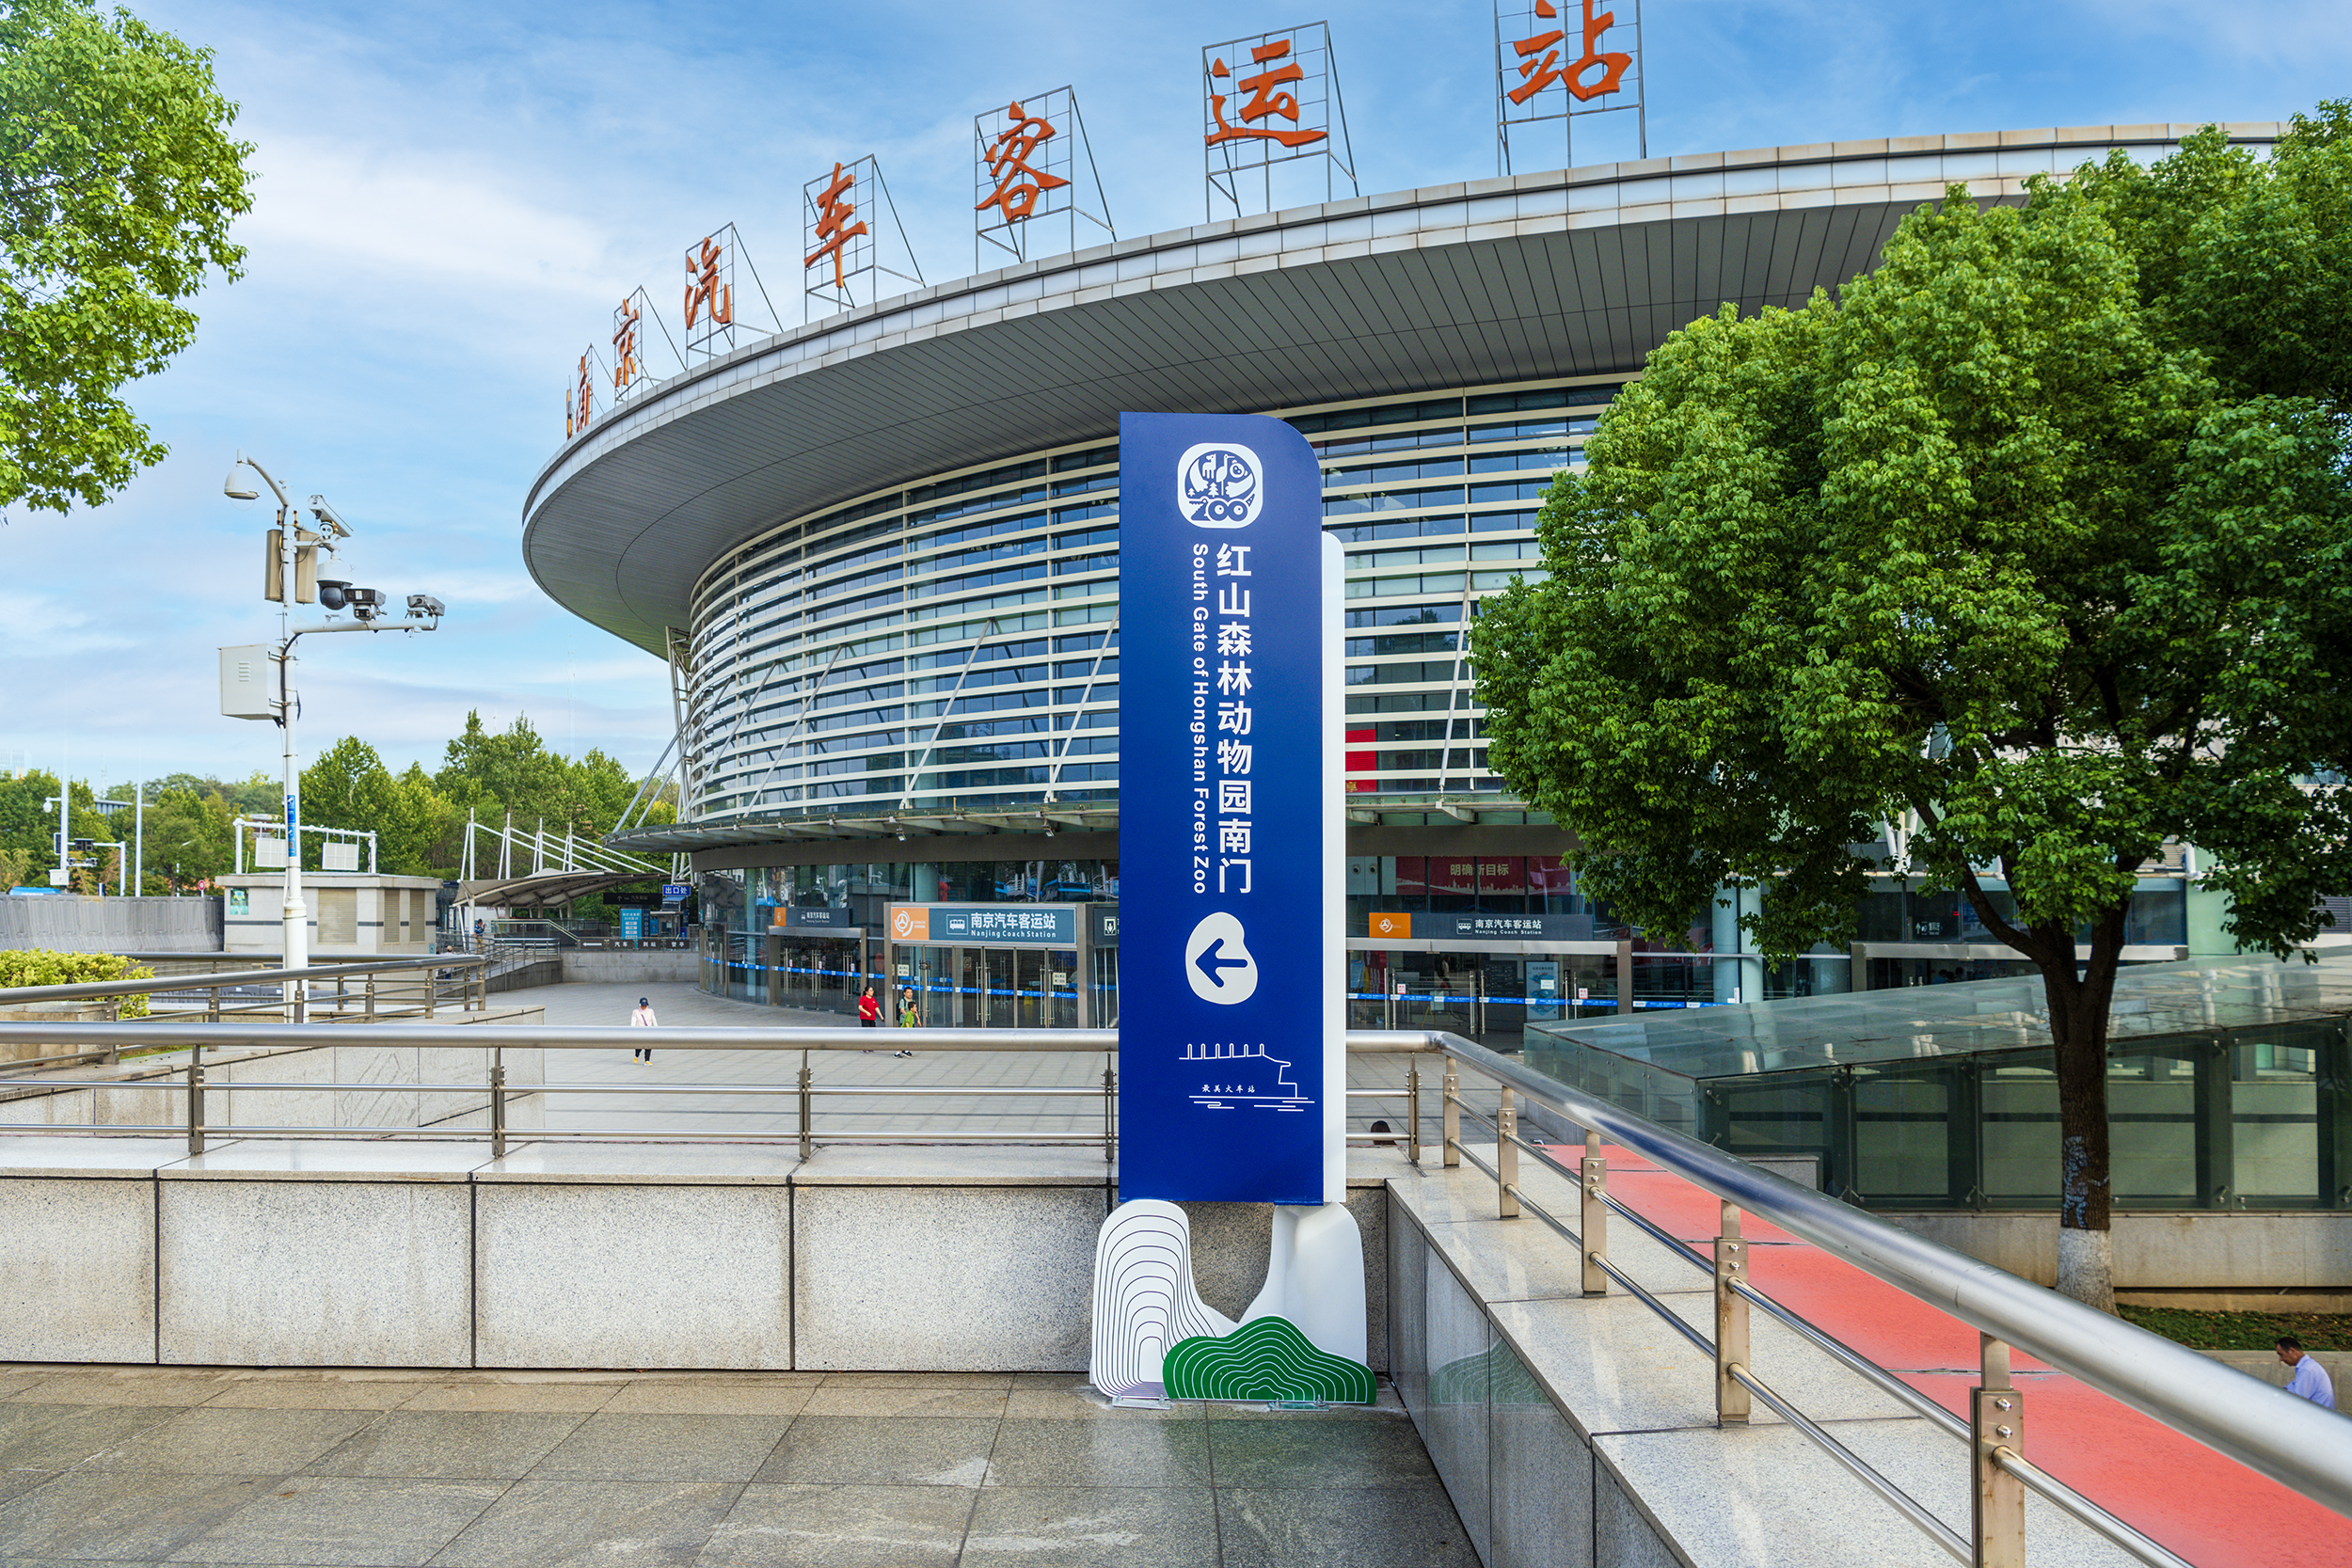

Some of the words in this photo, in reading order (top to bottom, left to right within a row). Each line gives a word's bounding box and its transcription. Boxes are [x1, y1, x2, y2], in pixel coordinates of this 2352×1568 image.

[1192, 543, 1209, 601] South
[1193, 606, 1209, 652] Gate
[1193, 657, 1209, 678] of
[1189, 681, 1209, 782] Hongshan
[1216, 542, 1253, 894] 红山森林动物园南门
[1193, 787, 1209, 852] Forest
[665, 886, 688, 895] 出口处
[1194, 855, 1209, 894] Zoo
[971, 912, 1056, 929] 南京汽车客运站
[1475, 919, 1542, 929] 南京汽车客运站
[1201, 1084, 1255, 1093] 最美火车站
